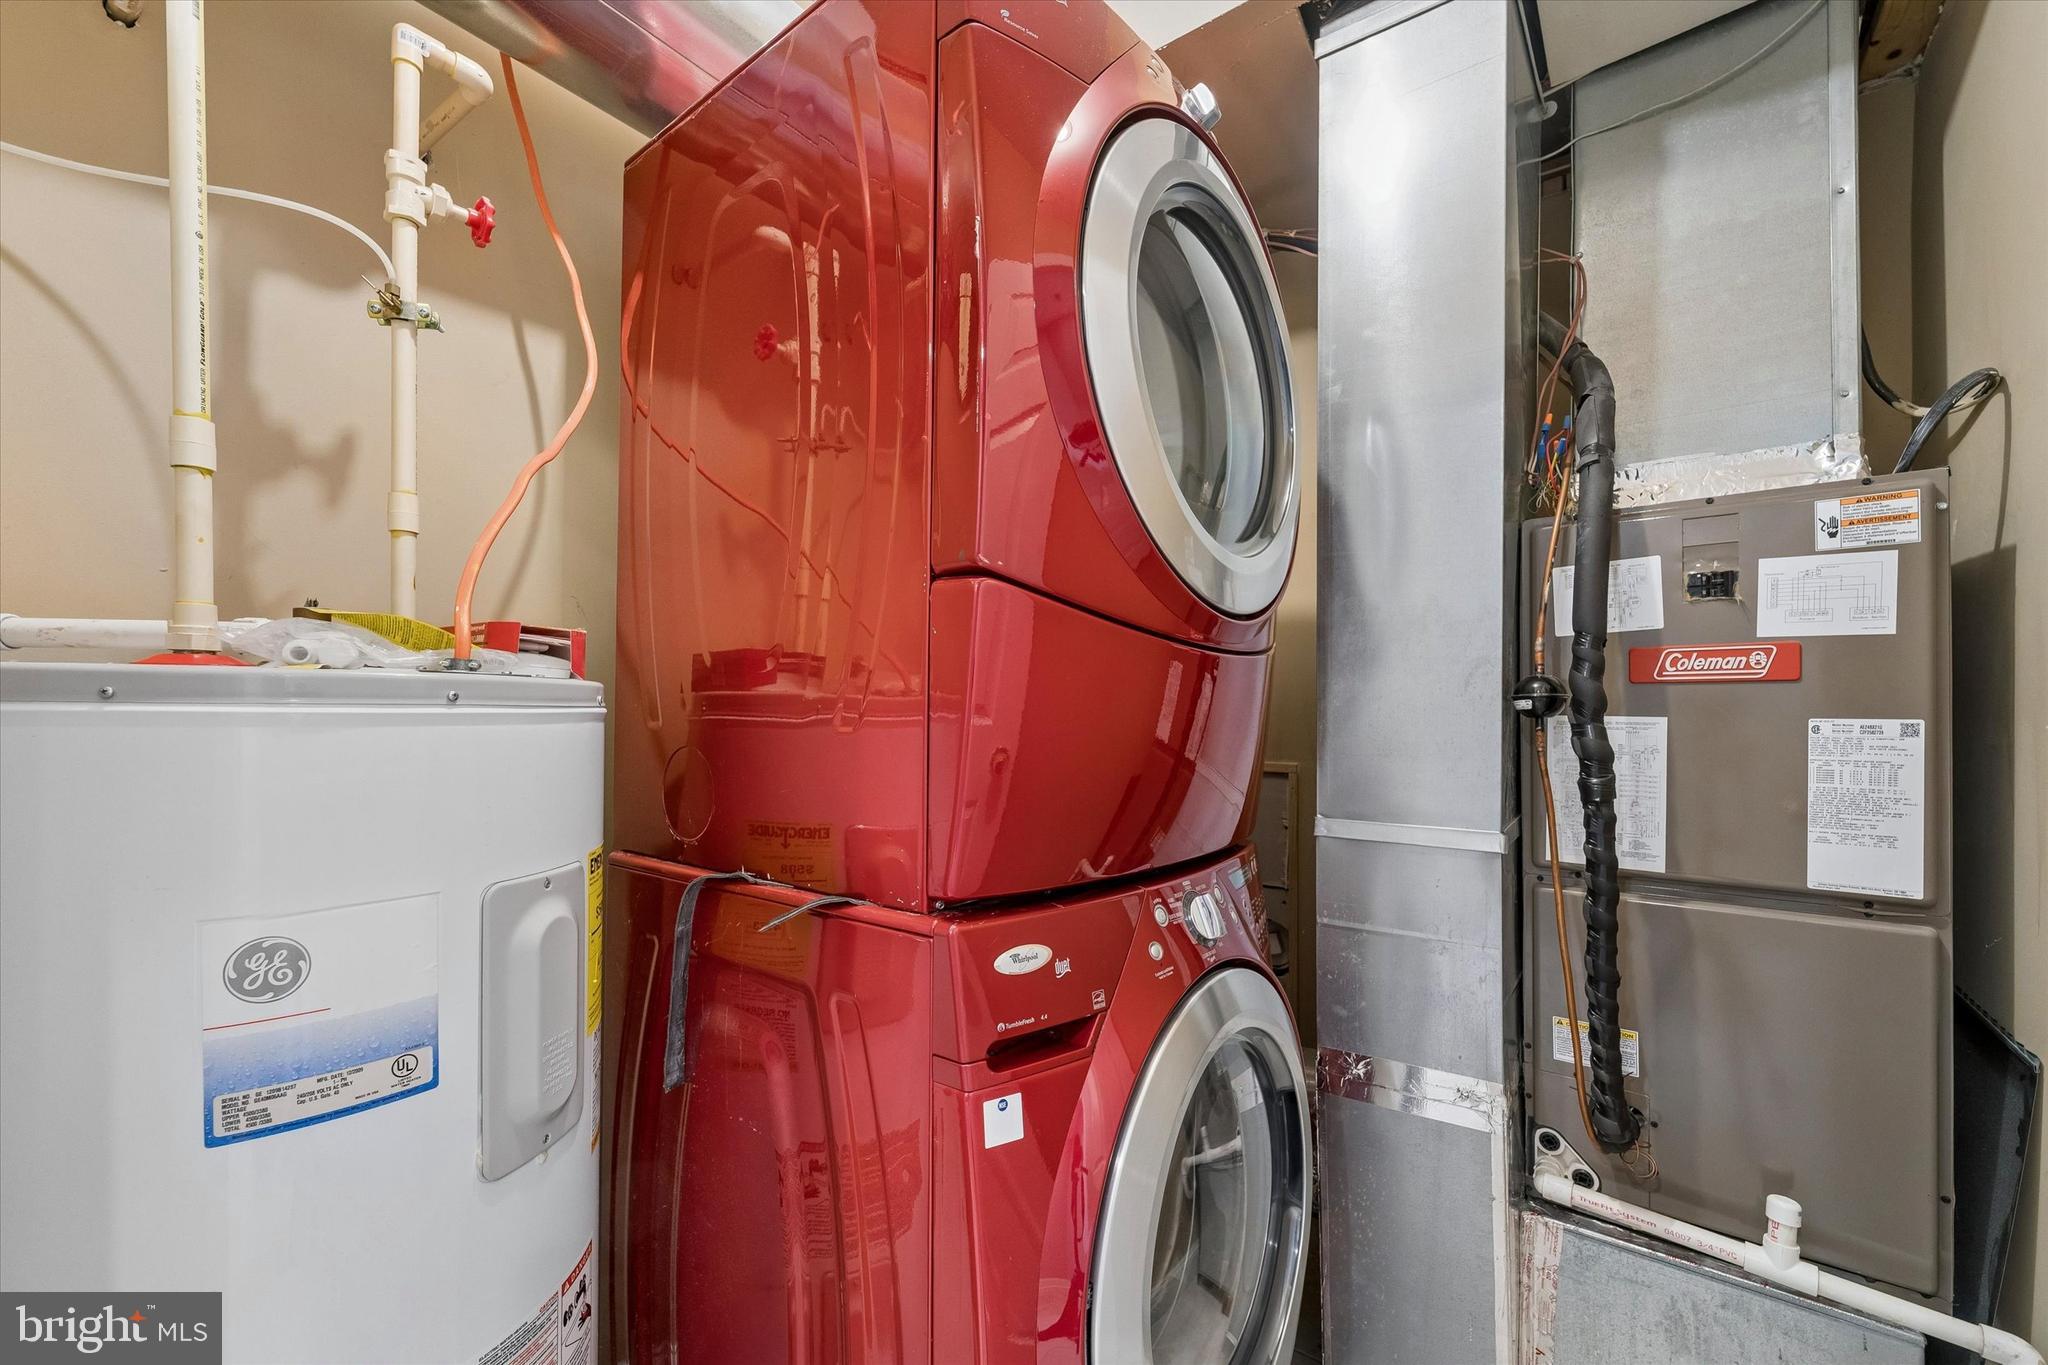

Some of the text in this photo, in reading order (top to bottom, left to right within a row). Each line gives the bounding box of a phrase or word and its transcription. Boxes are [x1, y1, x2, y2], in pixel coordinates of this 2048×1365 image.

[1864, 493, 1902, 502] WARNING
[1857, 514, 1911, 524] AVERTISSEMENT
[1665, 652, 1747, 672] Coleman
[1010, 952, 1039, 965] Whirlpool
[243, 949, 294, 990] GE
[1005, 1017, 1035, 1029] TumbleFresh
[397, 1059, 413, 1072] UL
[317, 1086, 332, 1094] VOLTS
[341, 1081, 353, 1089] ONLY
[221, 1096, 240, 1104] SERIAL
[222, 1106, 247, 1115] WATTAGE
[1616, 1207, 1657, 1229] System
